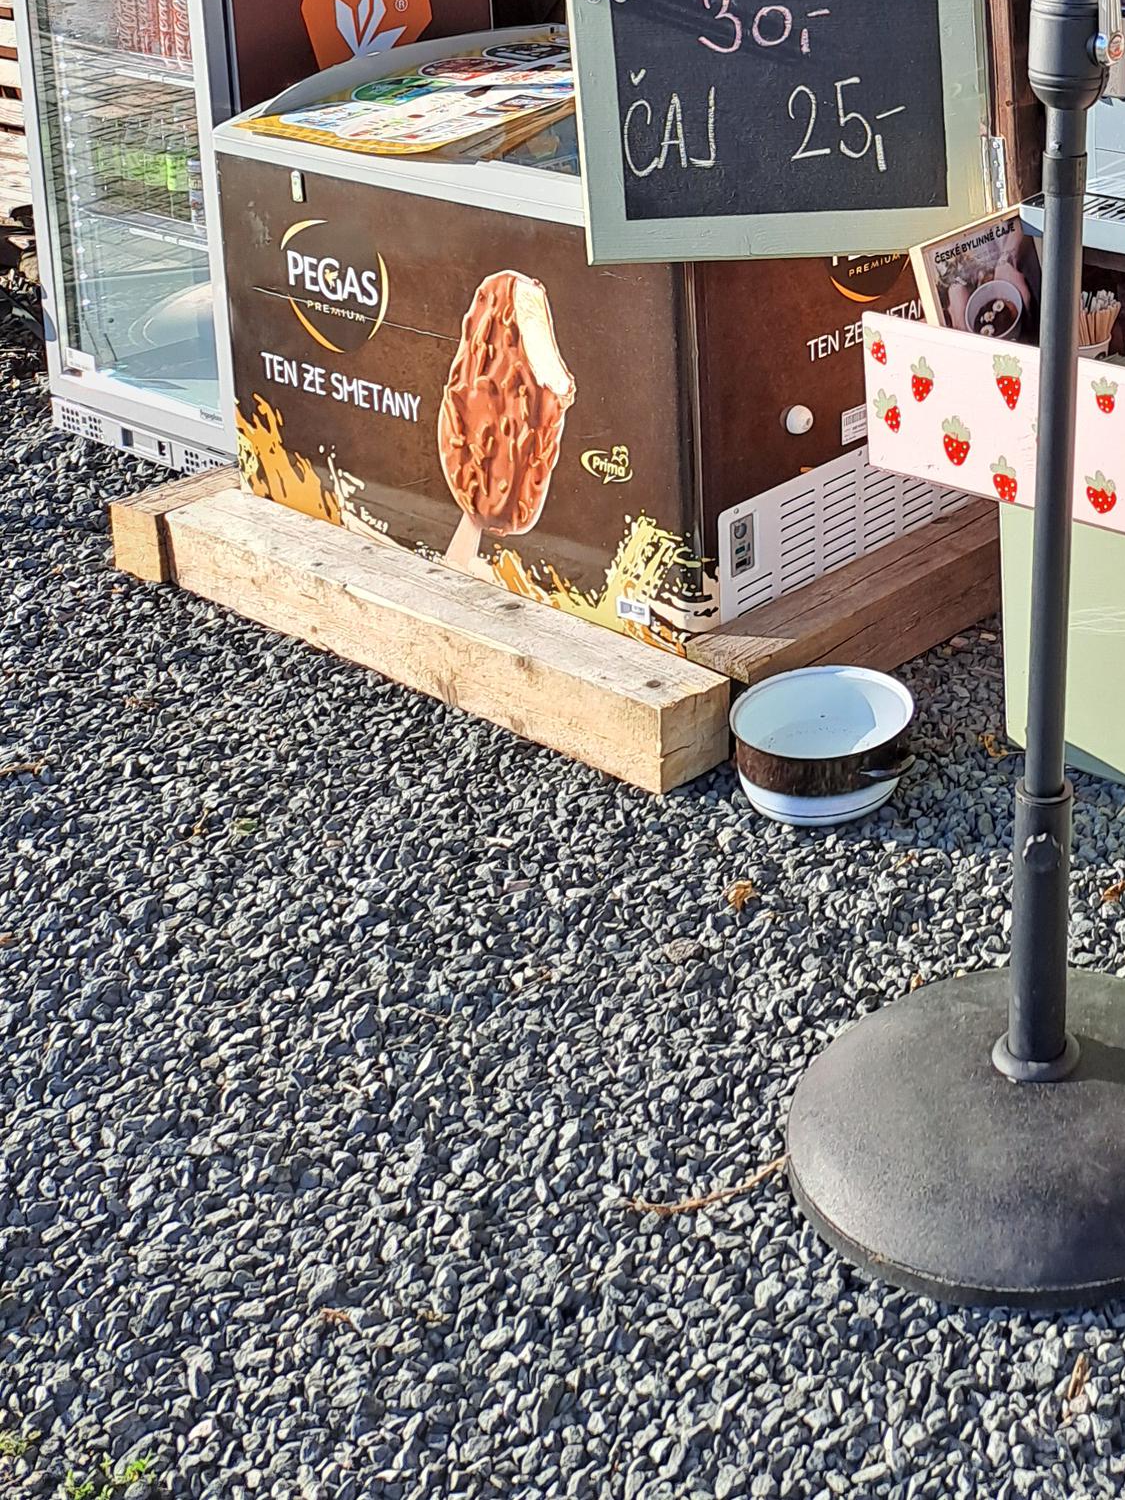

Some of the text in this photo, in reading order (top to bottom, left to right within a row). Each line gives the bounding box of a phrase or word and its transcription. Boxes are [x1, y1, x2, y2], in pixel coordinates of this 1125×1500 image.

[623, 67, 718, 177] ČAJ
[787, 76, 907, 173] 25,-
[934, 221, 1016, 264] ČESKÉ BYLINNÉ ČAJE
[286, 250, 379, 306] PEGAS
[848, 252, 901, 277] PREMIUM
[306, 299, 366, 324] PREMIUM
[806, 321, 863, 362] TEN ZE
[260, 351, 421, 423] TEN ZE SMETANY
[592, 455, 626, 477] Prima
